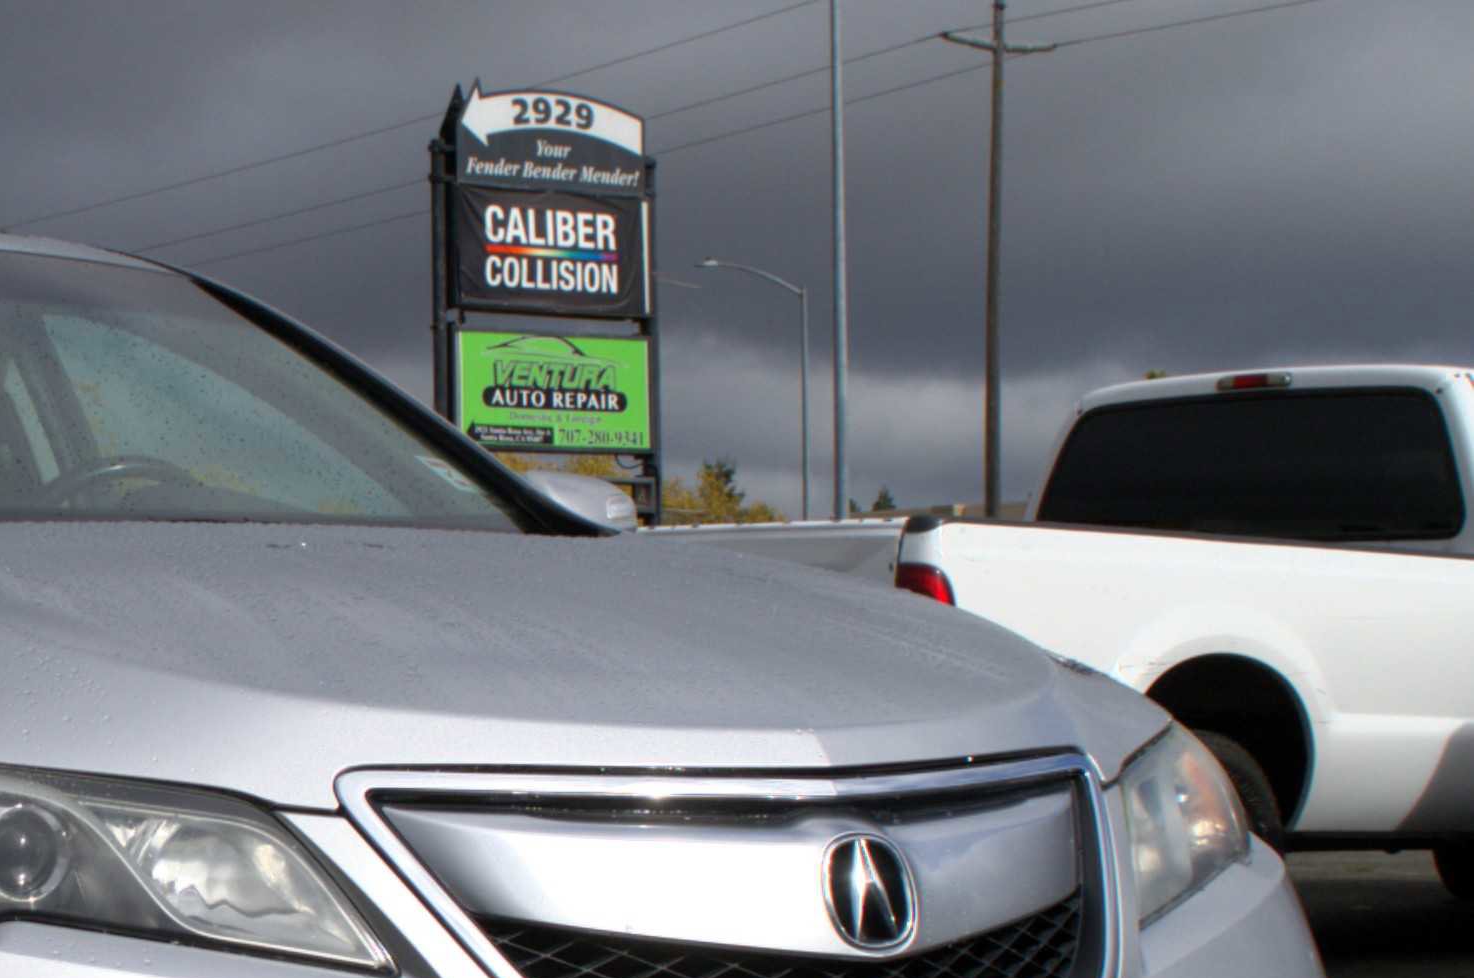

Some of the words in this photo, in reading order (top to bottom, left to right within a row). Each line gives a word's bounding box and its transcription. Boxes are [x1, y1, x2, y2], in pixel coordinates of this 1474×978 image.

[510, 97, 595, 130] 2929
[535, 138, 572, 159] Your
[466, 156, 520, 178] Fender
[523, 160, 575, 182] Bender
[579, 163, 640, 187] Mender!
[484, 204, 617, 251] CALIBER
[485, 255, 618, 295] COLLISION
[492, 359, 617, 391] VENTURA
[491, 388, 546, 409] AUTO
[553, 391, 620, 412] REPAIR
